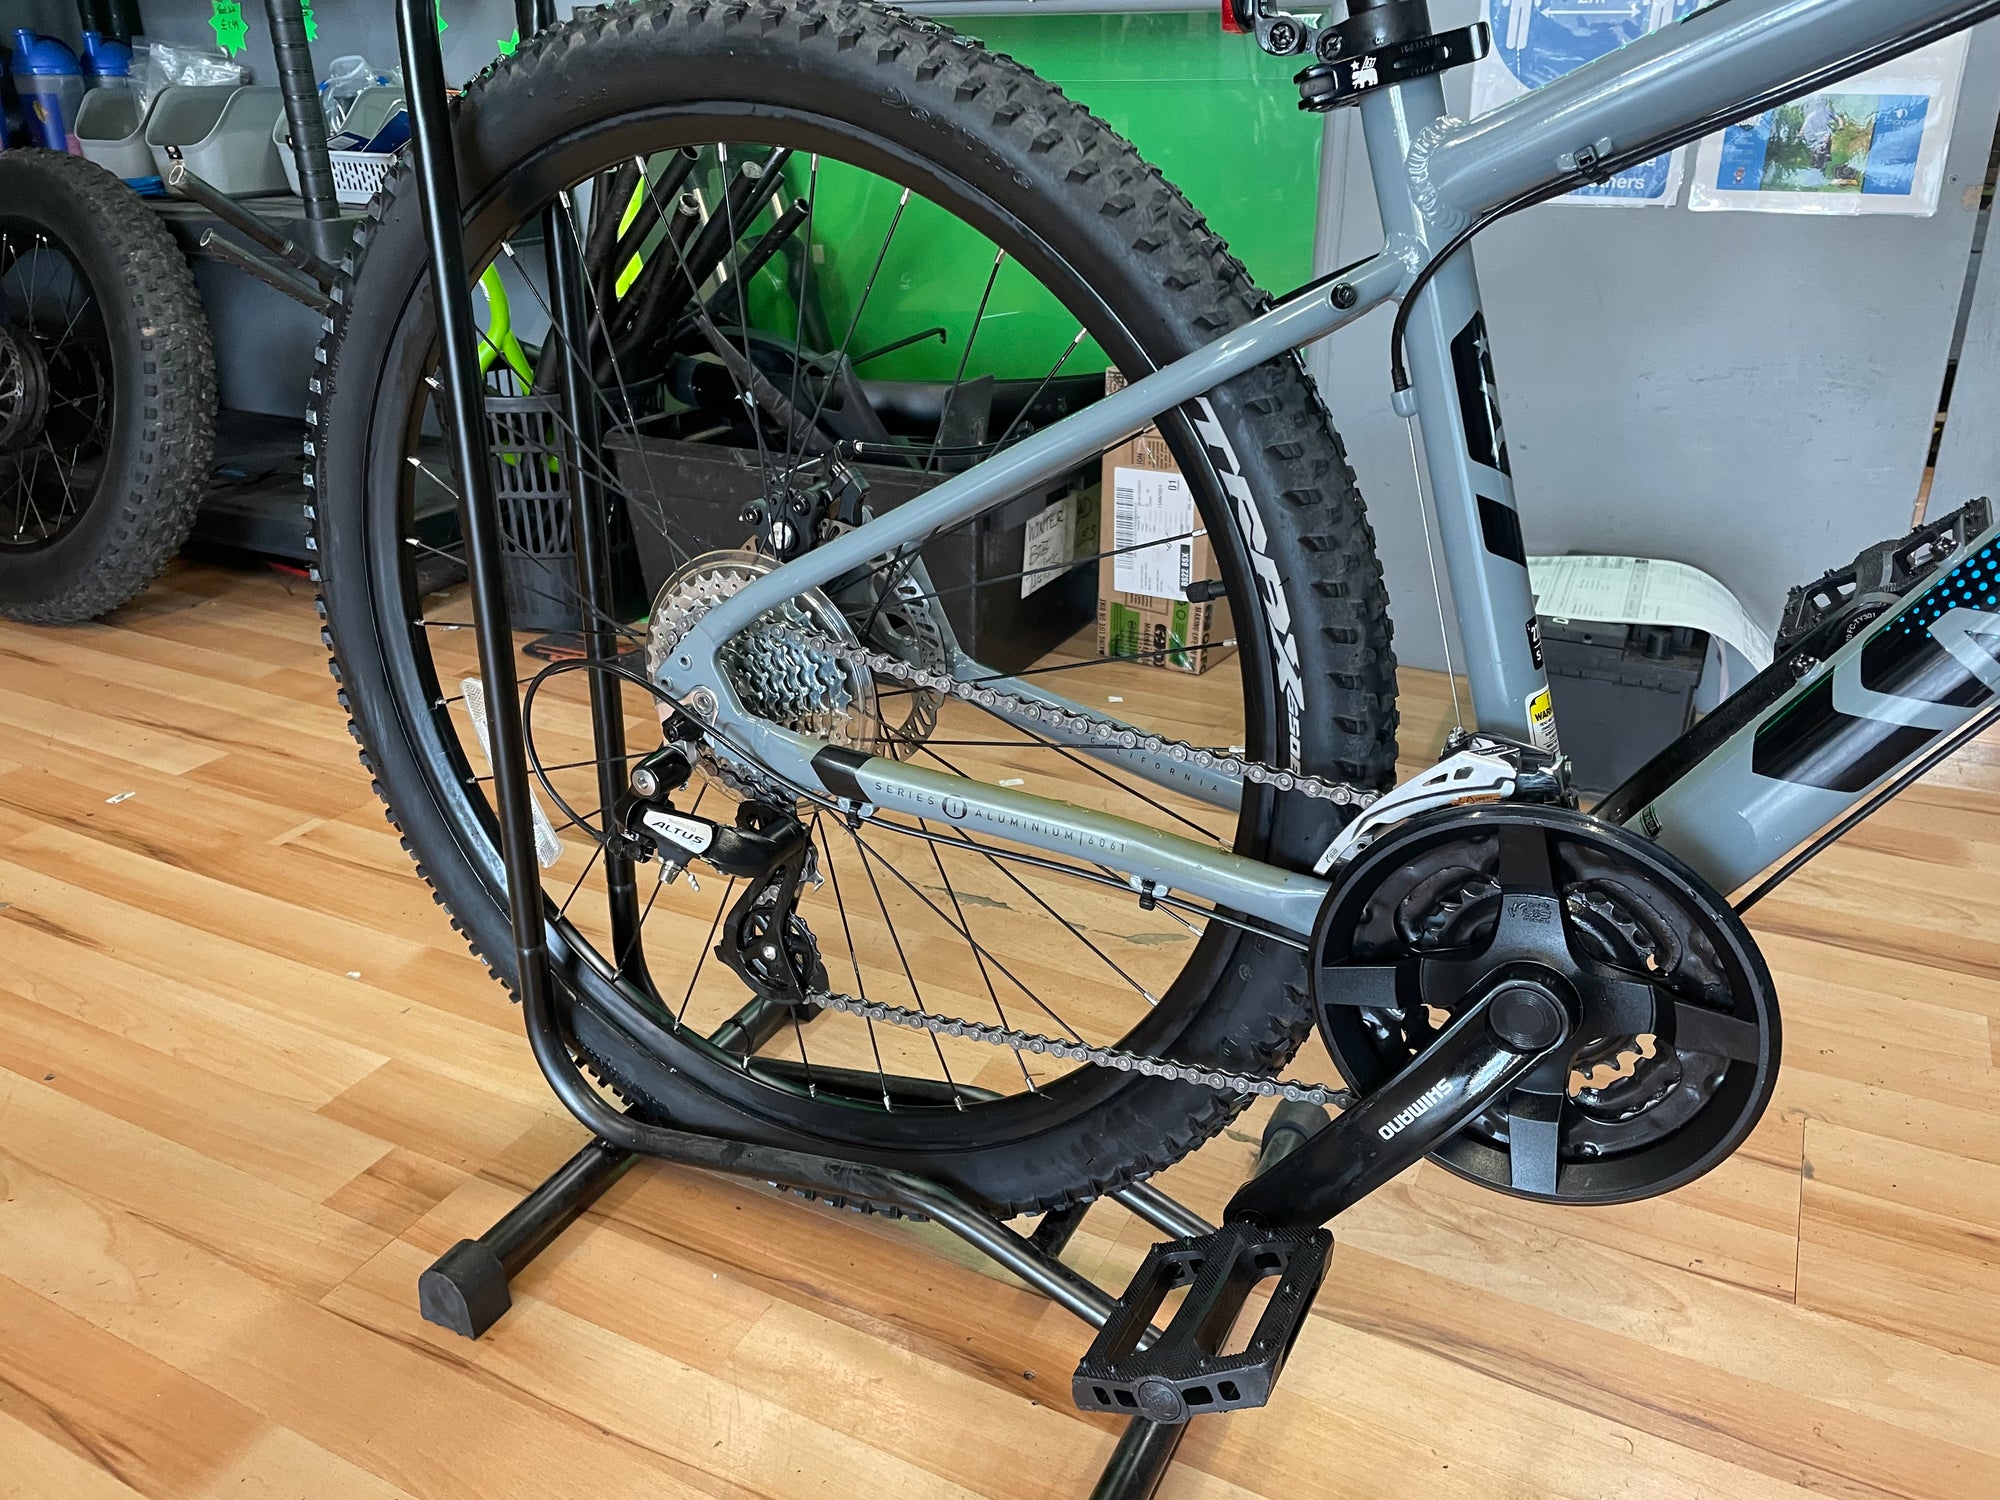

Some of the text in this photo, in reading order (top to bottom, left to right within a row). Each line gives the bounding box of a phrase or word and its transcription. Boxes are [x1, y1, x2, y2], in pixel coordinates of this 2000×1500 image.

[1193, 397, 1305, 711] TRAX
[652, 821, 705, 845] ALTUS
[875, 781, 935, 805] SERIES
[975, 810, 1075, 841] ALUMINIUM
[1087, 836, 1125, 853] 6061
[1378, 1077, 1454, 1141] SHIMANO
